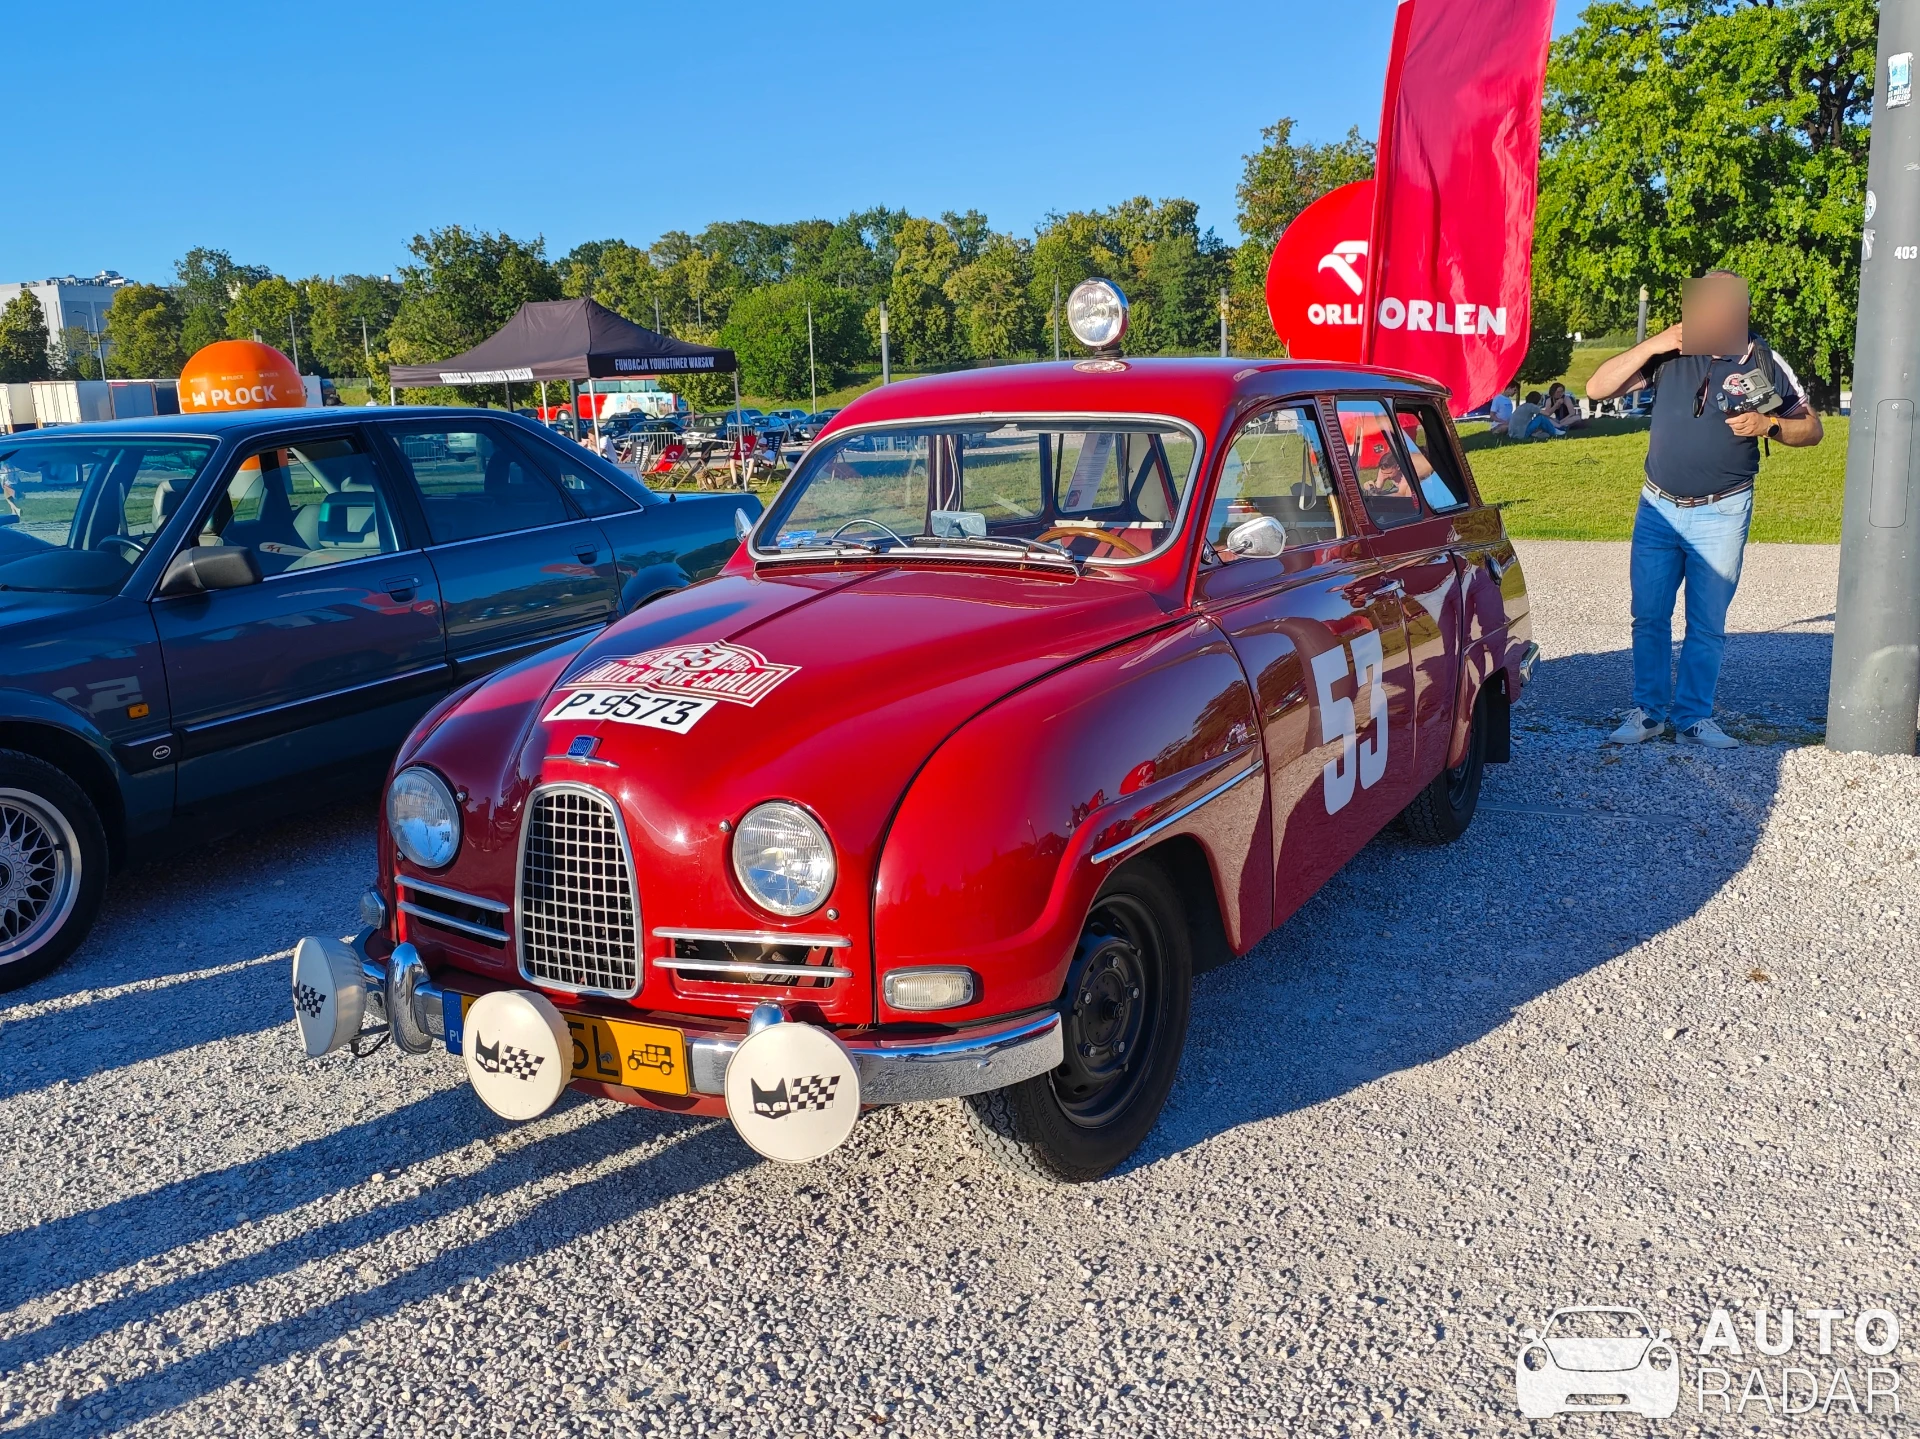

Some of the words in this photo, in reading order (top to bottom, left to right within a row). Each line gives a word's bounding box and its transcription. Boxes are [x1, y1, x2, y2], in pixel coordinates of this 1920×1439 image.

[1894, 246, 1918, 260] 403
[1378, 297, 1507, 335] ORLEN
[614, 358, 649, 371] FUNDACJA
[650, 356, 688, 369] YOUNGTIMER
[688, 356, 715, 368] WARSAW
[210, 385, 278, 407] PŁOCK
[661, 648, 725, 669] 53
[578, 661, 646, 683] RALLYE
[631, 669, 777, 695] MONTE-CARLO
[554, 693, 596, 717] P
[588, 693, 703, 726] 9573
[1311, 628, 1389, 816] 53
[449, 1029, 463, 1044] PL
